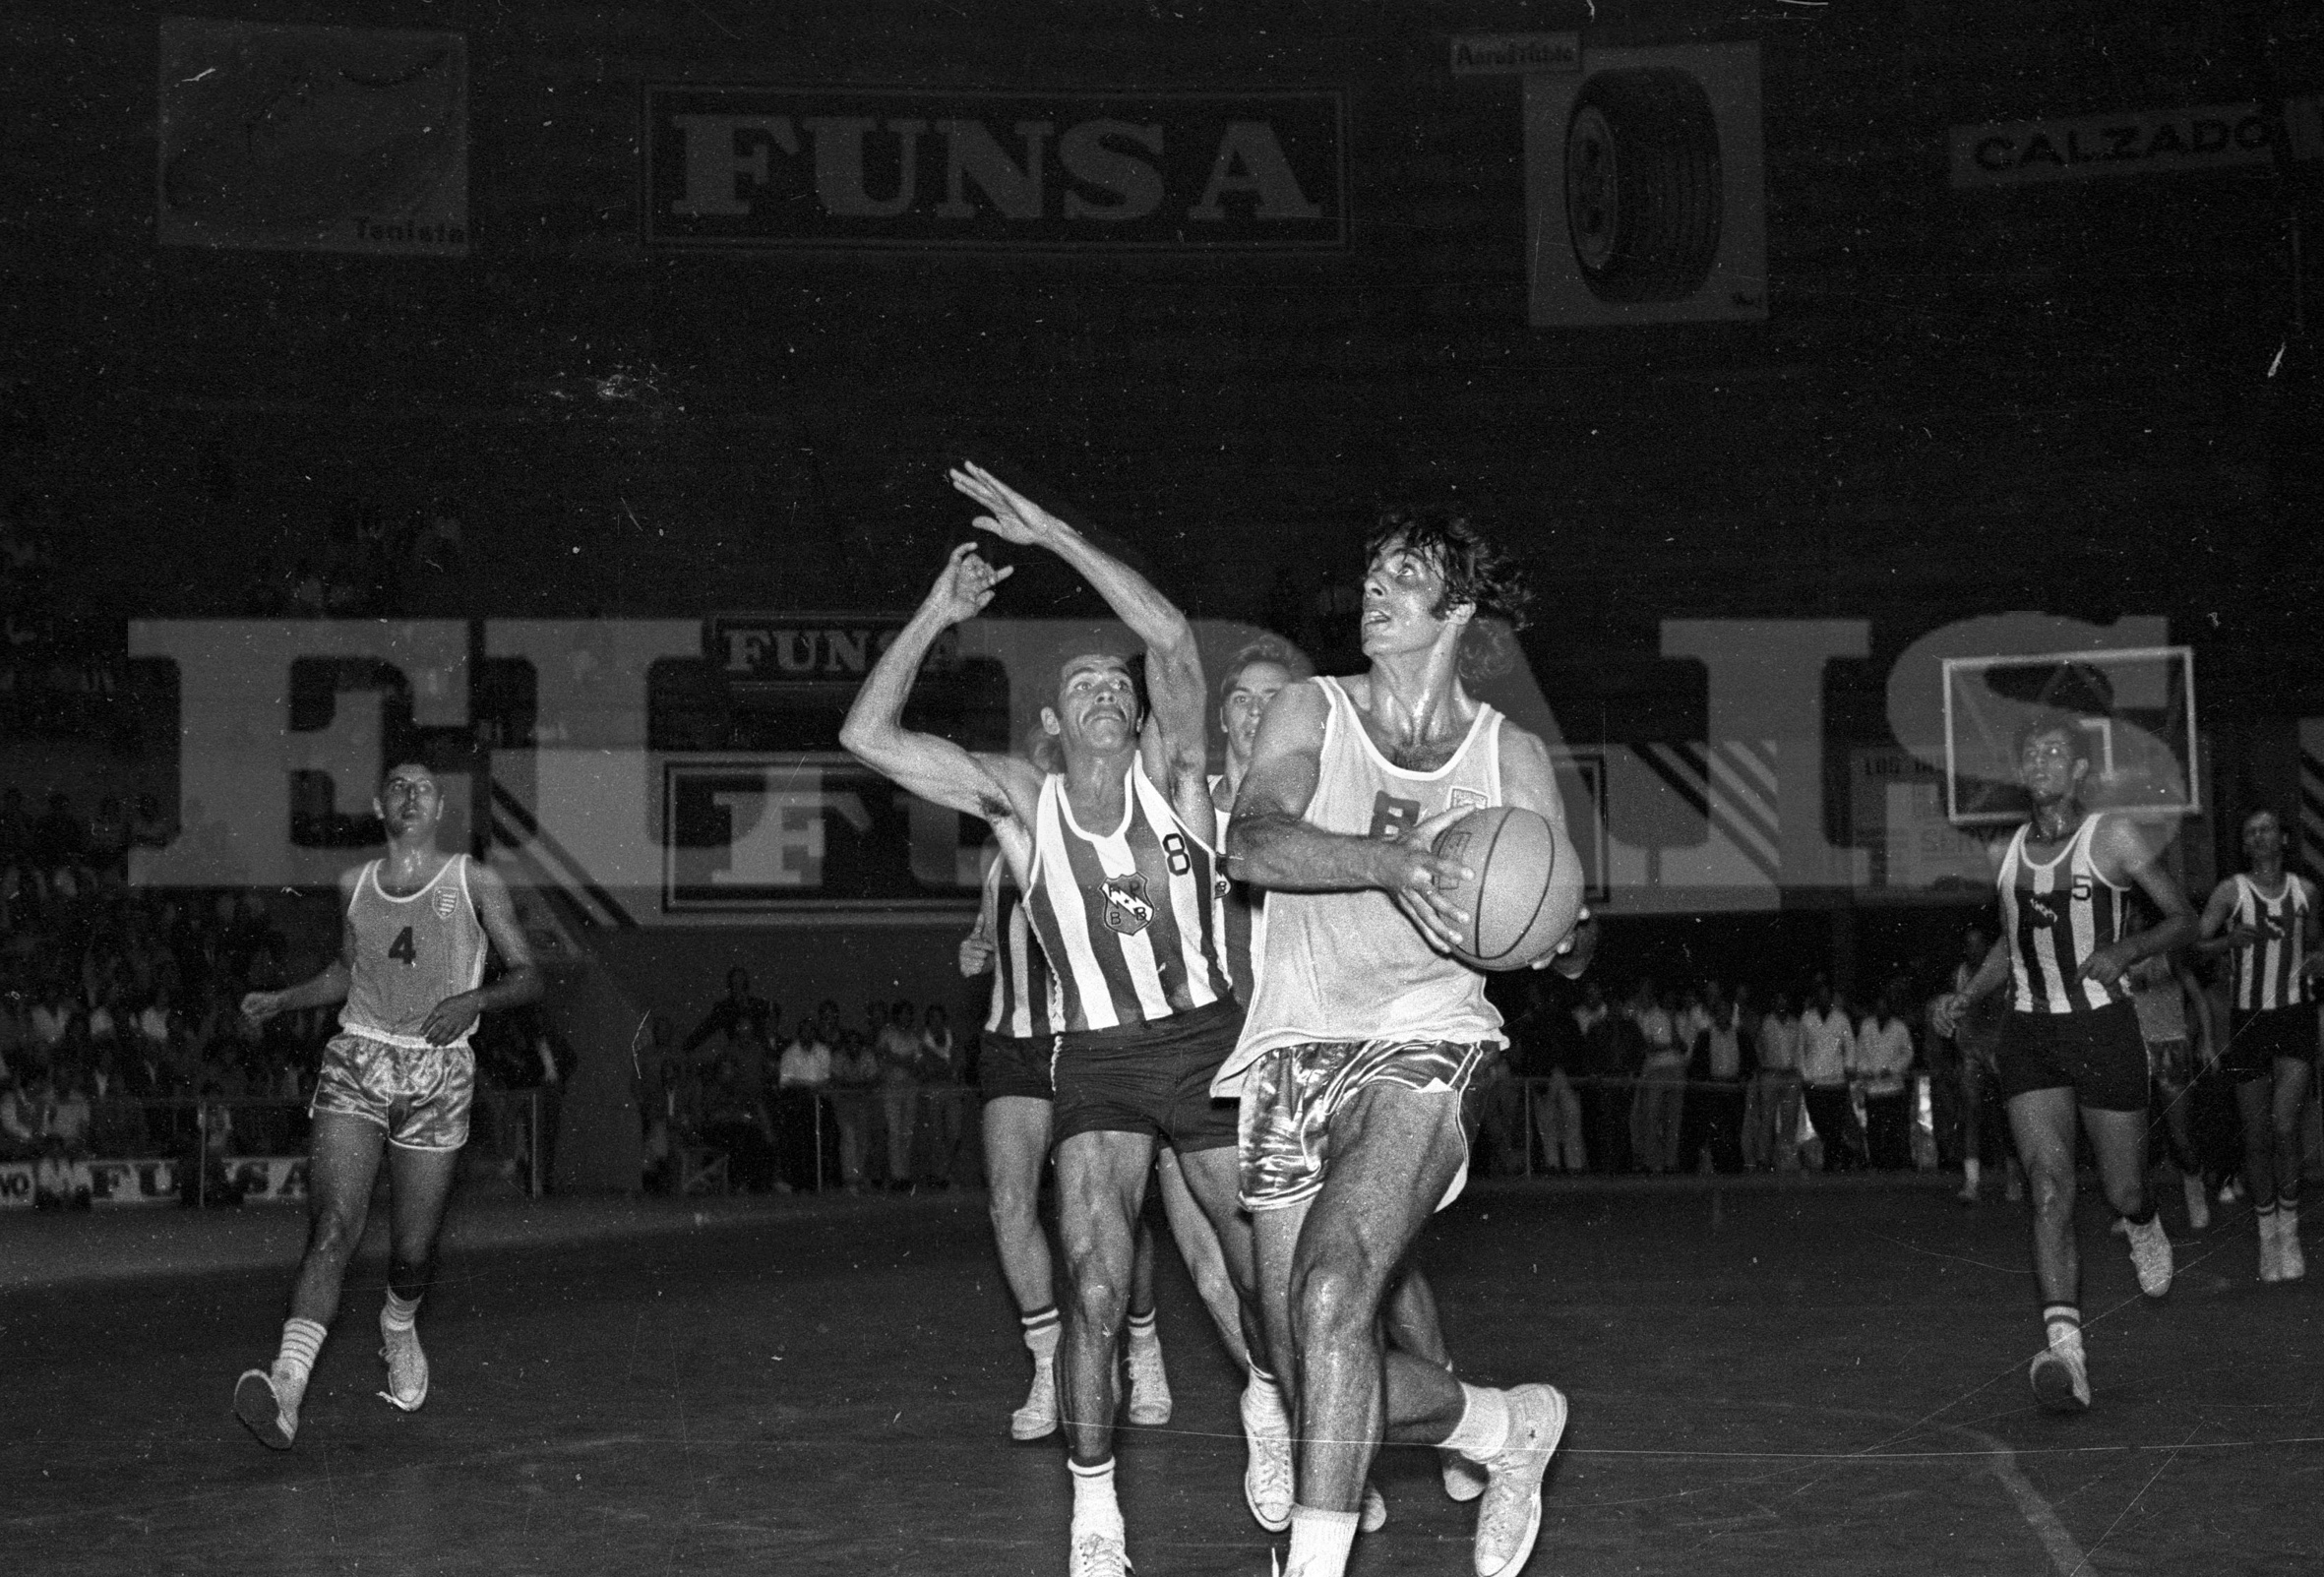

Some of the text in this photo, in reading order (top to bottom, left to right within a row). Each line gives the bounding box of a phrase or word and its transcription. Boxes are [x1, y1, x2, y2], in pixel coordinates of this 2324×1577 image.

[671, 113, 1323, 221] FUNSA
[352, 215, 465, 244] Tenista
[722, 629, 969, 672] FUNA
[1162, 832, 1192, 876] 8
[2071, 874, 2093, 901] 5
[388, 926, 416, 965] 4
